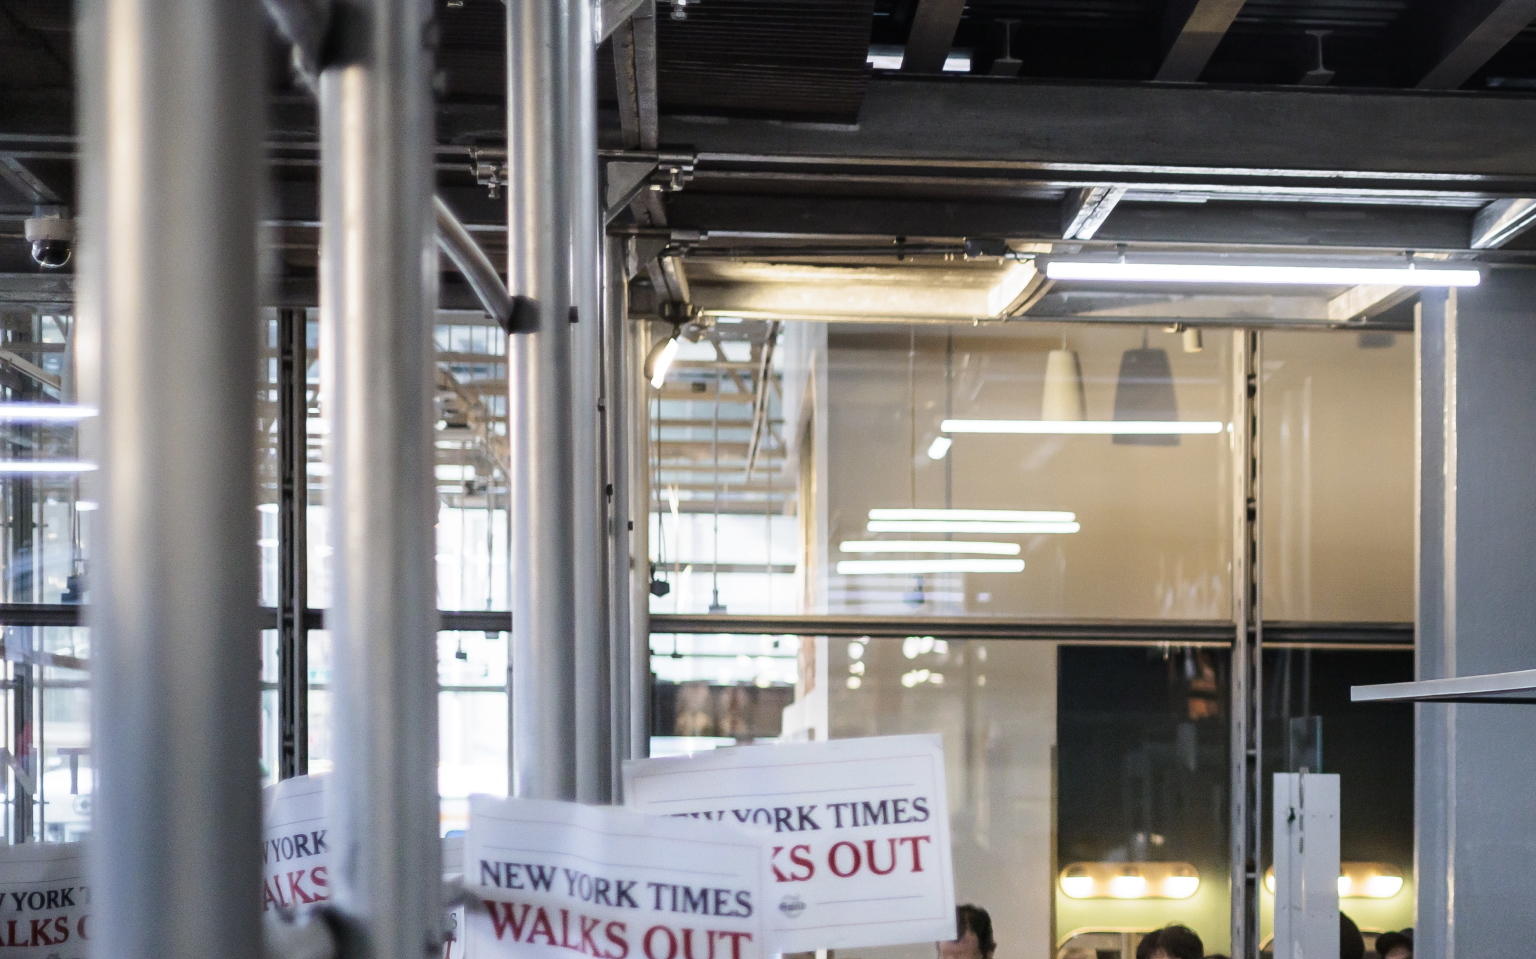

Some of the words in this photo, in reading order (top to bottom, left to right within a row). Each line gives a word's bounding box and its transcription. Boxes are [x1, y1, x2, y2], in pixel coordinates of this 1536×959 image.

[827, 796, 931, 829] TIMES
[271, 829, 329, 863] YORK
[828, 835, 931, 878] OUT
[11, 887, 76, 912] YORK
[263, 866, 330, 912] ALKS
[480, 860, 557, 892] NEW
[563, 868, 639, 909] YORK
[647, 882, 753, 919] TIMES
